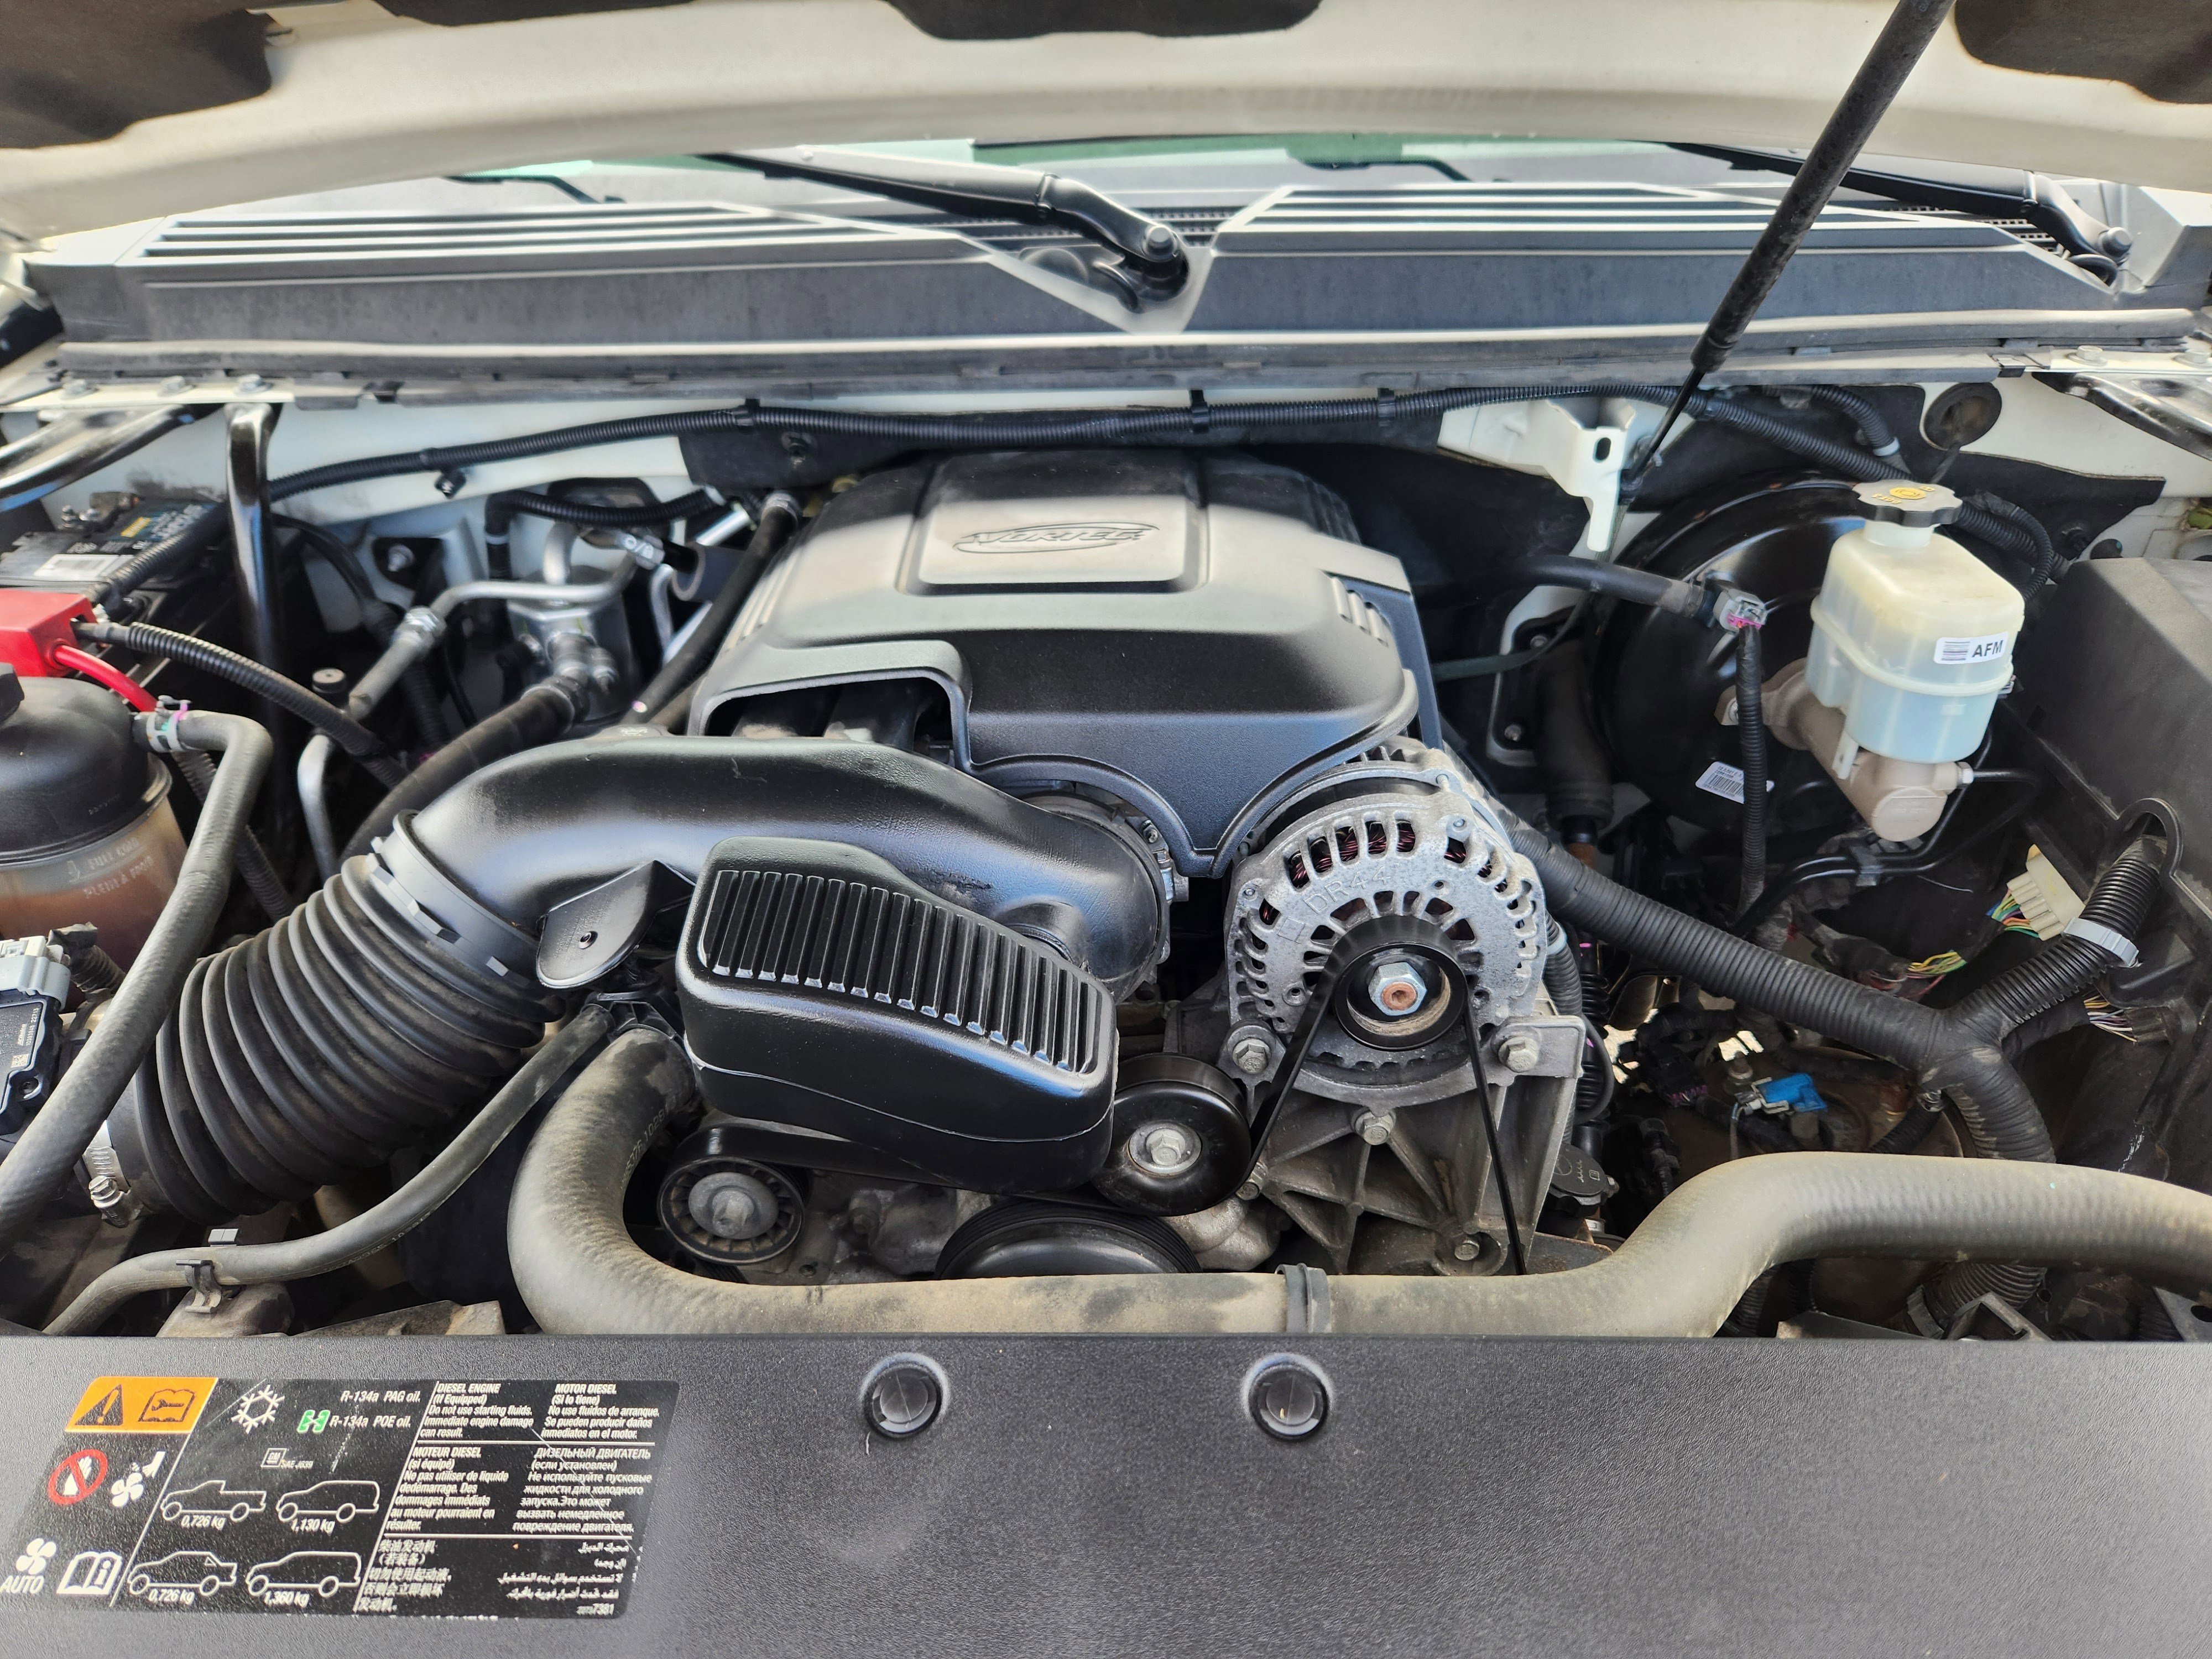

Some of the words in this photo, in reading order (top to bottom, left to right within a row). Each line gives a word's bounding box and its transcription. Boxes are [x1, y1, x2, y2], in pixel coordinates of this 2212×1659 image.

[962, 529, 1145, 546] VORTEC
[1971, 640, 2004, 658] AFM
[436, 1383, 466, 1394] DIESEL
[468, 1383, 501, 1394] ENGINE
[555, 1384, 587, 1394] MOTOR
[587, 1384, 617, 1394] DIESEL
[341, 1390, 378, 1403] R-134a
[384, 1390, 404, 1403] PAG
[405, 1390, 421, 1404] oil.
[444, 1394, 487, 1406] Equipped)
[565, 1395, 574, 1405] lo
[575, 1395, 600, 1406] tiene)
[428, 1405, 441, 1416] Do
[441, 1405, 457, 1416] not
[457, 1407, 473, 1416] use
[473, 1405, 507, 1417] starting
[507, 1405, 533, 1416] fluids.
[547, 1405, 561, 1416] No
[561, 1406, 577, 1416] use
[578, 1405, 607, 1417] fluidos
[608, 1406, 619, 1416] de
[620, 1407, 660, 1418] arranque.
[329, 1415, 368, 1428] R-134a
[373, 1416, 396, 1428] POE
[396, 1416, 411, 1428] oil.
[424, 1416, 468, 1427] Immediate
[470, 1417, 498, 1428] engine
[499, 1417, 534, 1429] damage
[544, 1416, 556, 1427] Se
[557, 1417, 589, 1429] pueden
[589, 1417, 626, 1428] producir
[626, 1417, 653, 1428] daños
[420, 1428, 436, 1438] can
[436, 1427, 463, 1438] result.
[541, 1427, 587, 1438] inmediatos
[588, 1430, 600, 1438] en
[601, 1428, 611, 1438] el
[268, 1452, 281, 1461] GM
[412, 1447, 451, 1458] MOTEUR
[451, 1447, 482, 1458] DIESEL
[534, 1447, 596, 1460] ДИЗЕЛЬНЫЙ
[596, 1448, 651, 1460] ДВИГАТЕЛЬ
[421, 1458, 455, 1472] équipé)
[531, 1459, 557, 1472] (если
[558, 1459, 618, 1473] установлен)
[403, 1470, 416, 1481] Ne
[416, 1472, 435, 1483] pas
[435, 1470, 466, 1482] utiliser
[466, 1470, 478, 1482] de
[479, 1470, 509, 1484] liquide
[528, 1471, 542, 1482] Не
[542, 1472, 604, 1483] используйте
[606, 1474, 653, 1485] пусковые
[459, 1483, 478, 1493] Des
[523, 1485, 571, 1496] жидкости
[571, 1486, 591, 1496] для
[591, 1486, 644, 1497] холодного
[394, 1494, 443, 1508] dommages
[444, 1494, 491, 1507] immédiats
[579, 1498, 612, 1507] может
[390, 1509, 403, 1518] au
[403, 1507, 436, 1519] moteur
[435, 1507, 483, 1521] pourraient
[482, 1509, 495, 1519] en
[516, 1510, 556, 1520] вызвать
[211, 1516, 226, 1531] kg
[319, 1519, 336, 1535] kg
[512, 1522, 581, 1534] повреждение
[0, 1575, 44, 1594] AUTO
[179, 1590, 195, 1604] kg
[294, 1592, 310, 1608] kg
